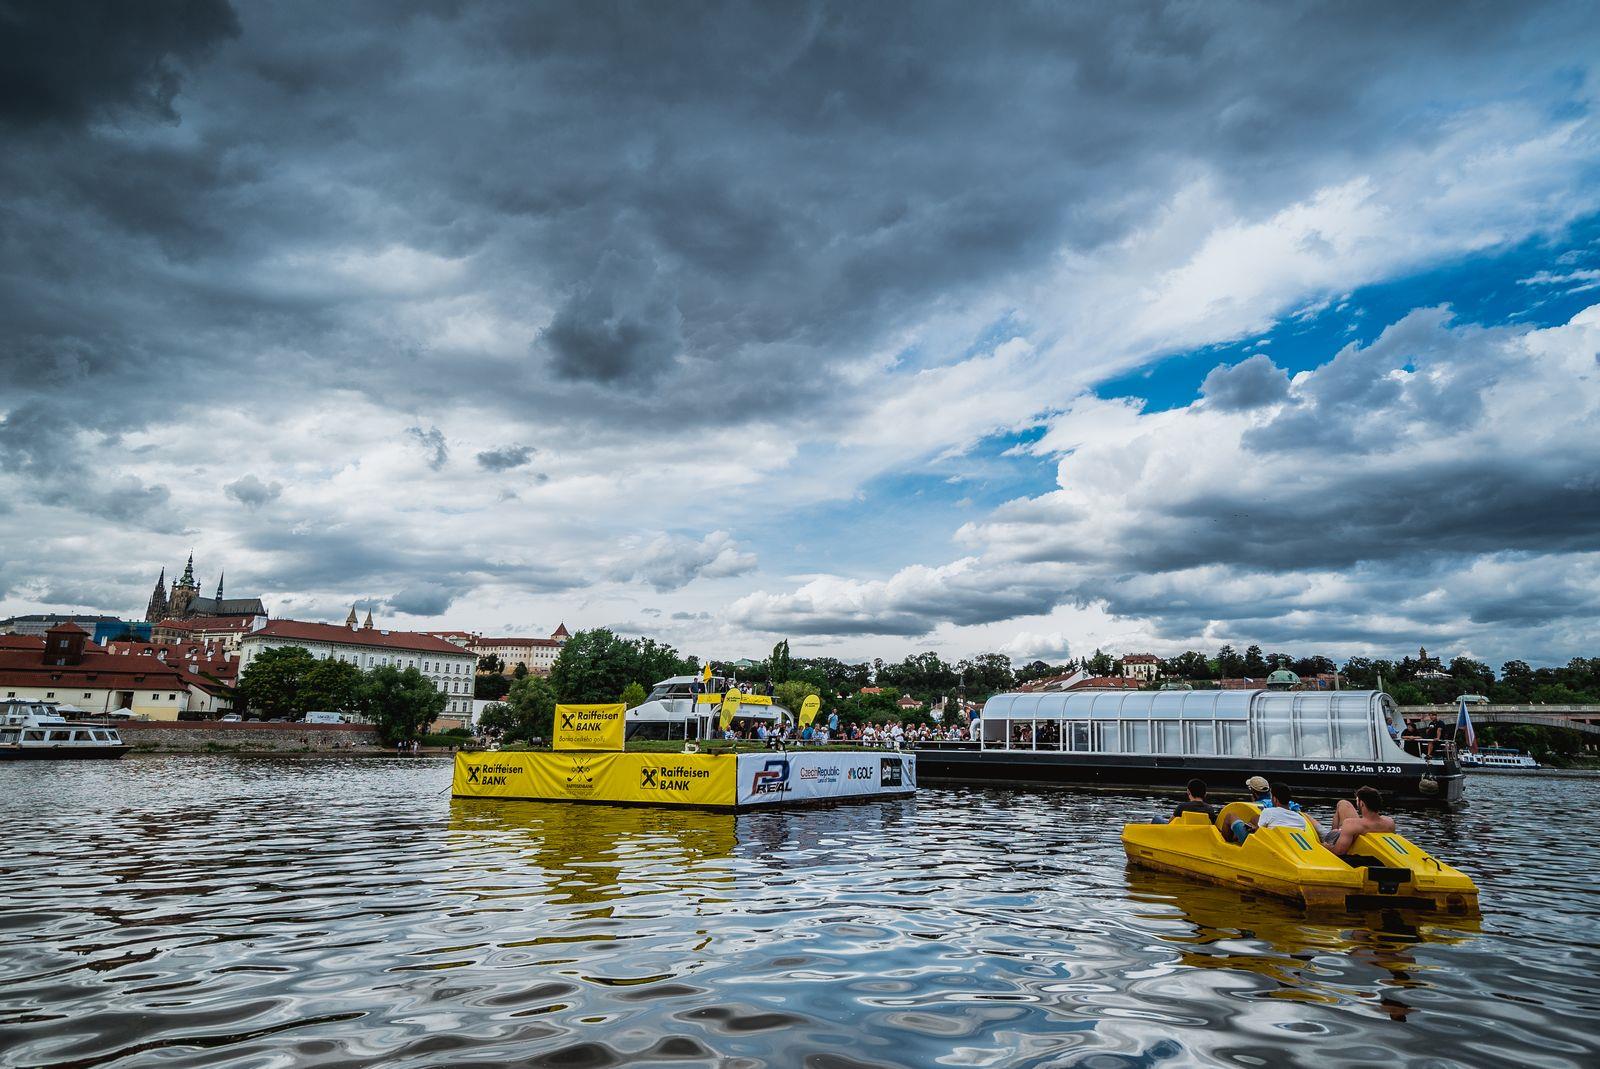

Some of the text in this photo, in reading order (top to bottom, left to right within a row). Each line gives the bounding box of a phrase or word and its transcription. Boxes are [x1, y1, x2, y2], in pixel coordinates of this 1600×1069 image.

[577, 711, 619, 720] Raiffeisen
[576, 722, 602, 731] BANK
[482, 764, 523, 774] Raiffeisen
[660, 766, 710, 778] Raiffeisen
[856, 766, 873, 780] GOLF
[1340, 764, 1348, 772] B.
[1349, 764, 1374, 773] 7,54m
[1377, 765, 1385, 773] P.
[1386, 766, 1402, 774] 220
[482, 776, 507, 785] BANK
[660, 780, 690, 791] BANK
[755, 781, 792, 795] REAL
